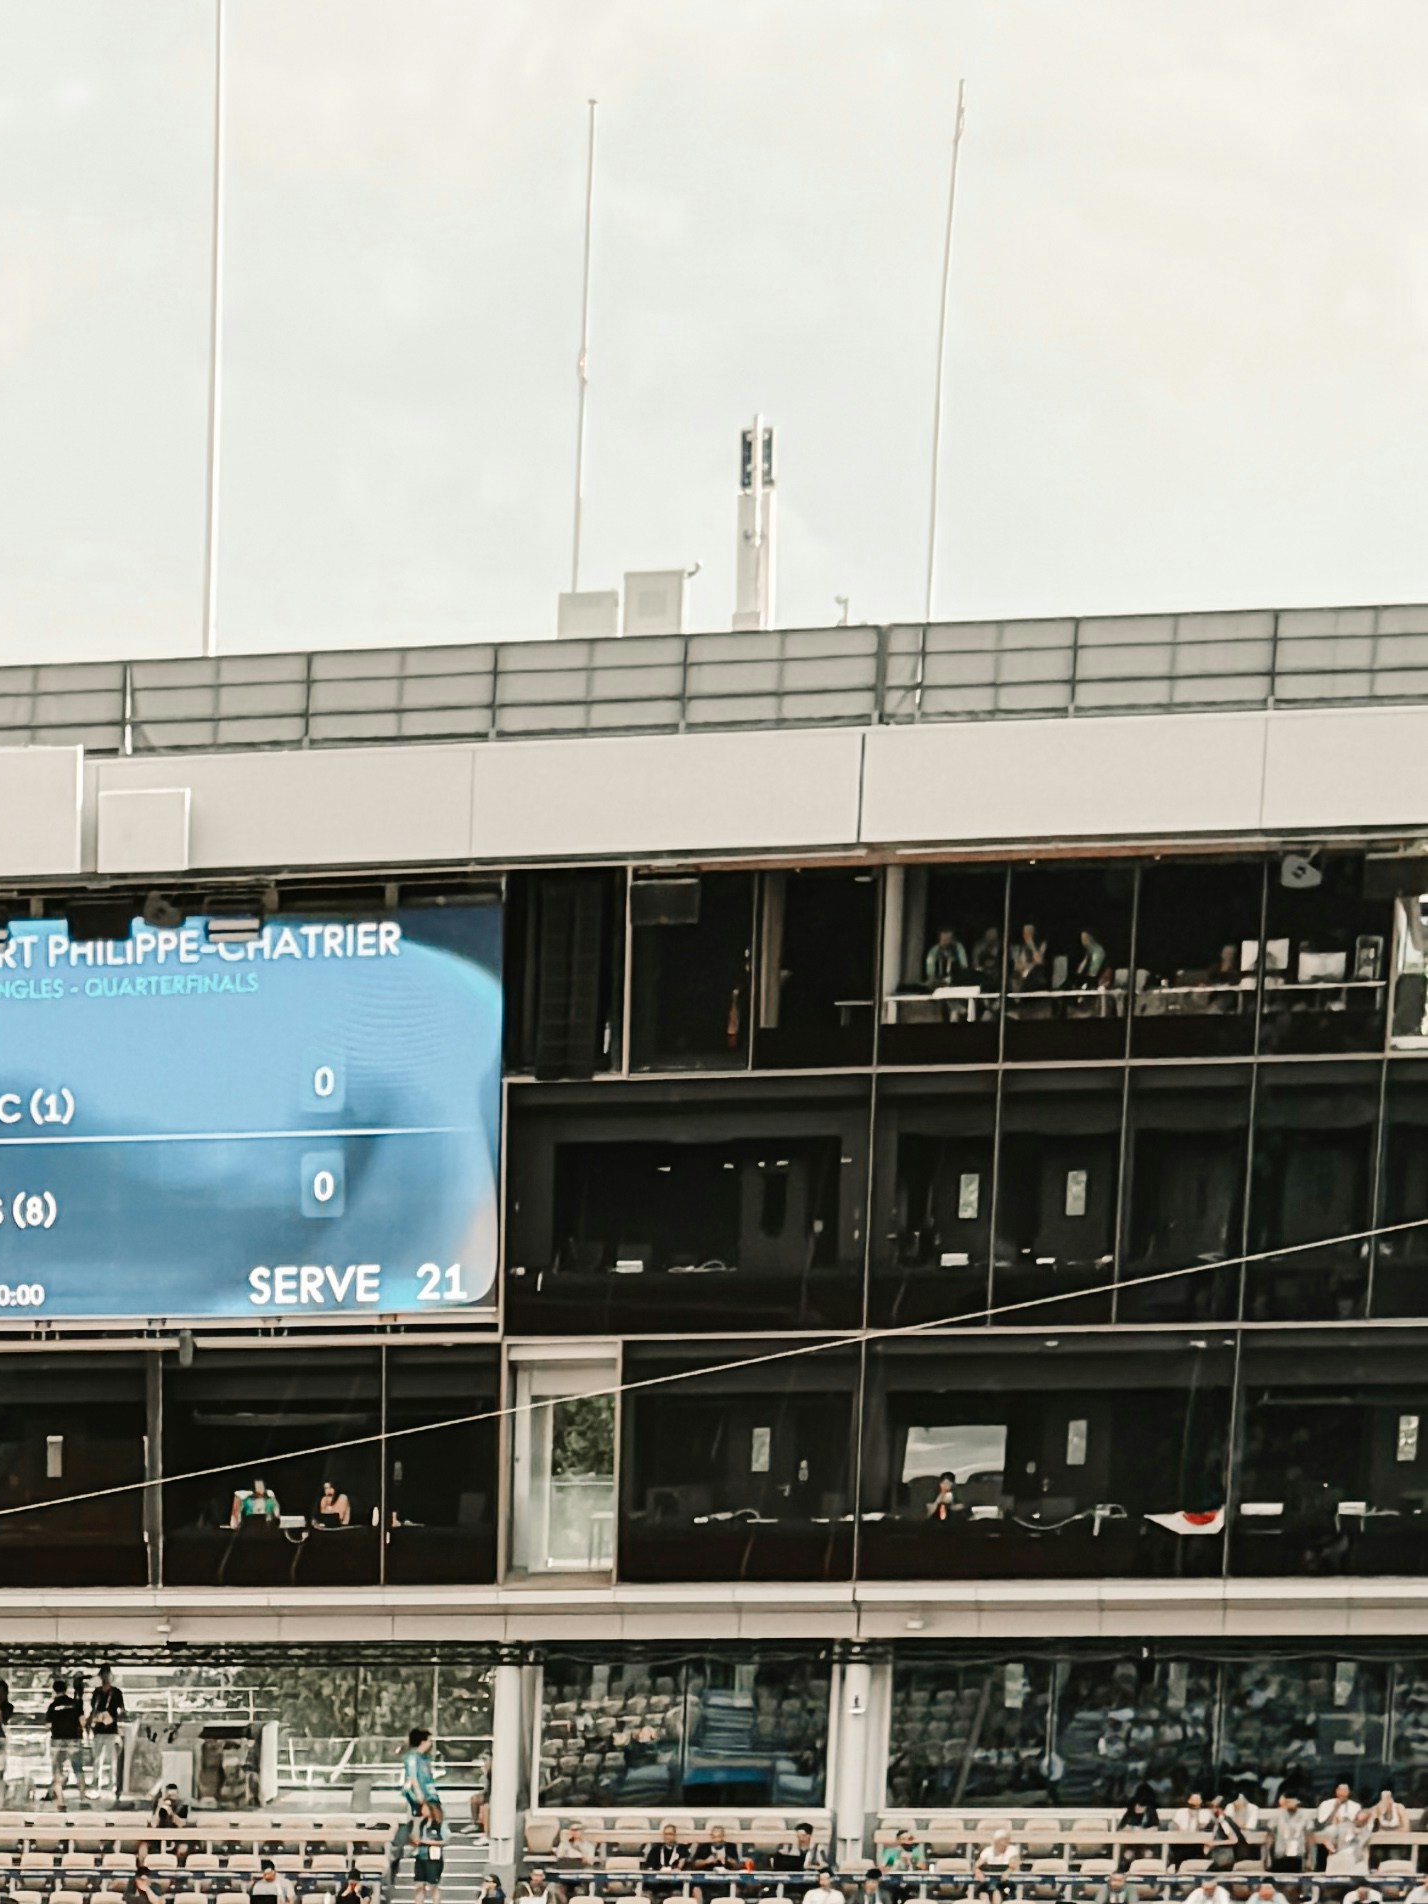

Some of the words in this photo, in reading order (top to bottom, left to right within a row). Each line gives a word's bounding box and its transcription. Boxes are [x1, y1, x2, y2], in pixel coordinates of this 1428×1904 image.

[84, 971, 258, 998] QUARTERFINALS
[313, 1066, 335, 1098] 0
[29, 1088, 75, 1126] (1)
[313, 1171, 335, 1202] 0
[12, 1193, 57, 1230] (8)
[248, 1264, 380, 1306] SERVE
[416, 1262, 467, 1301] 21
